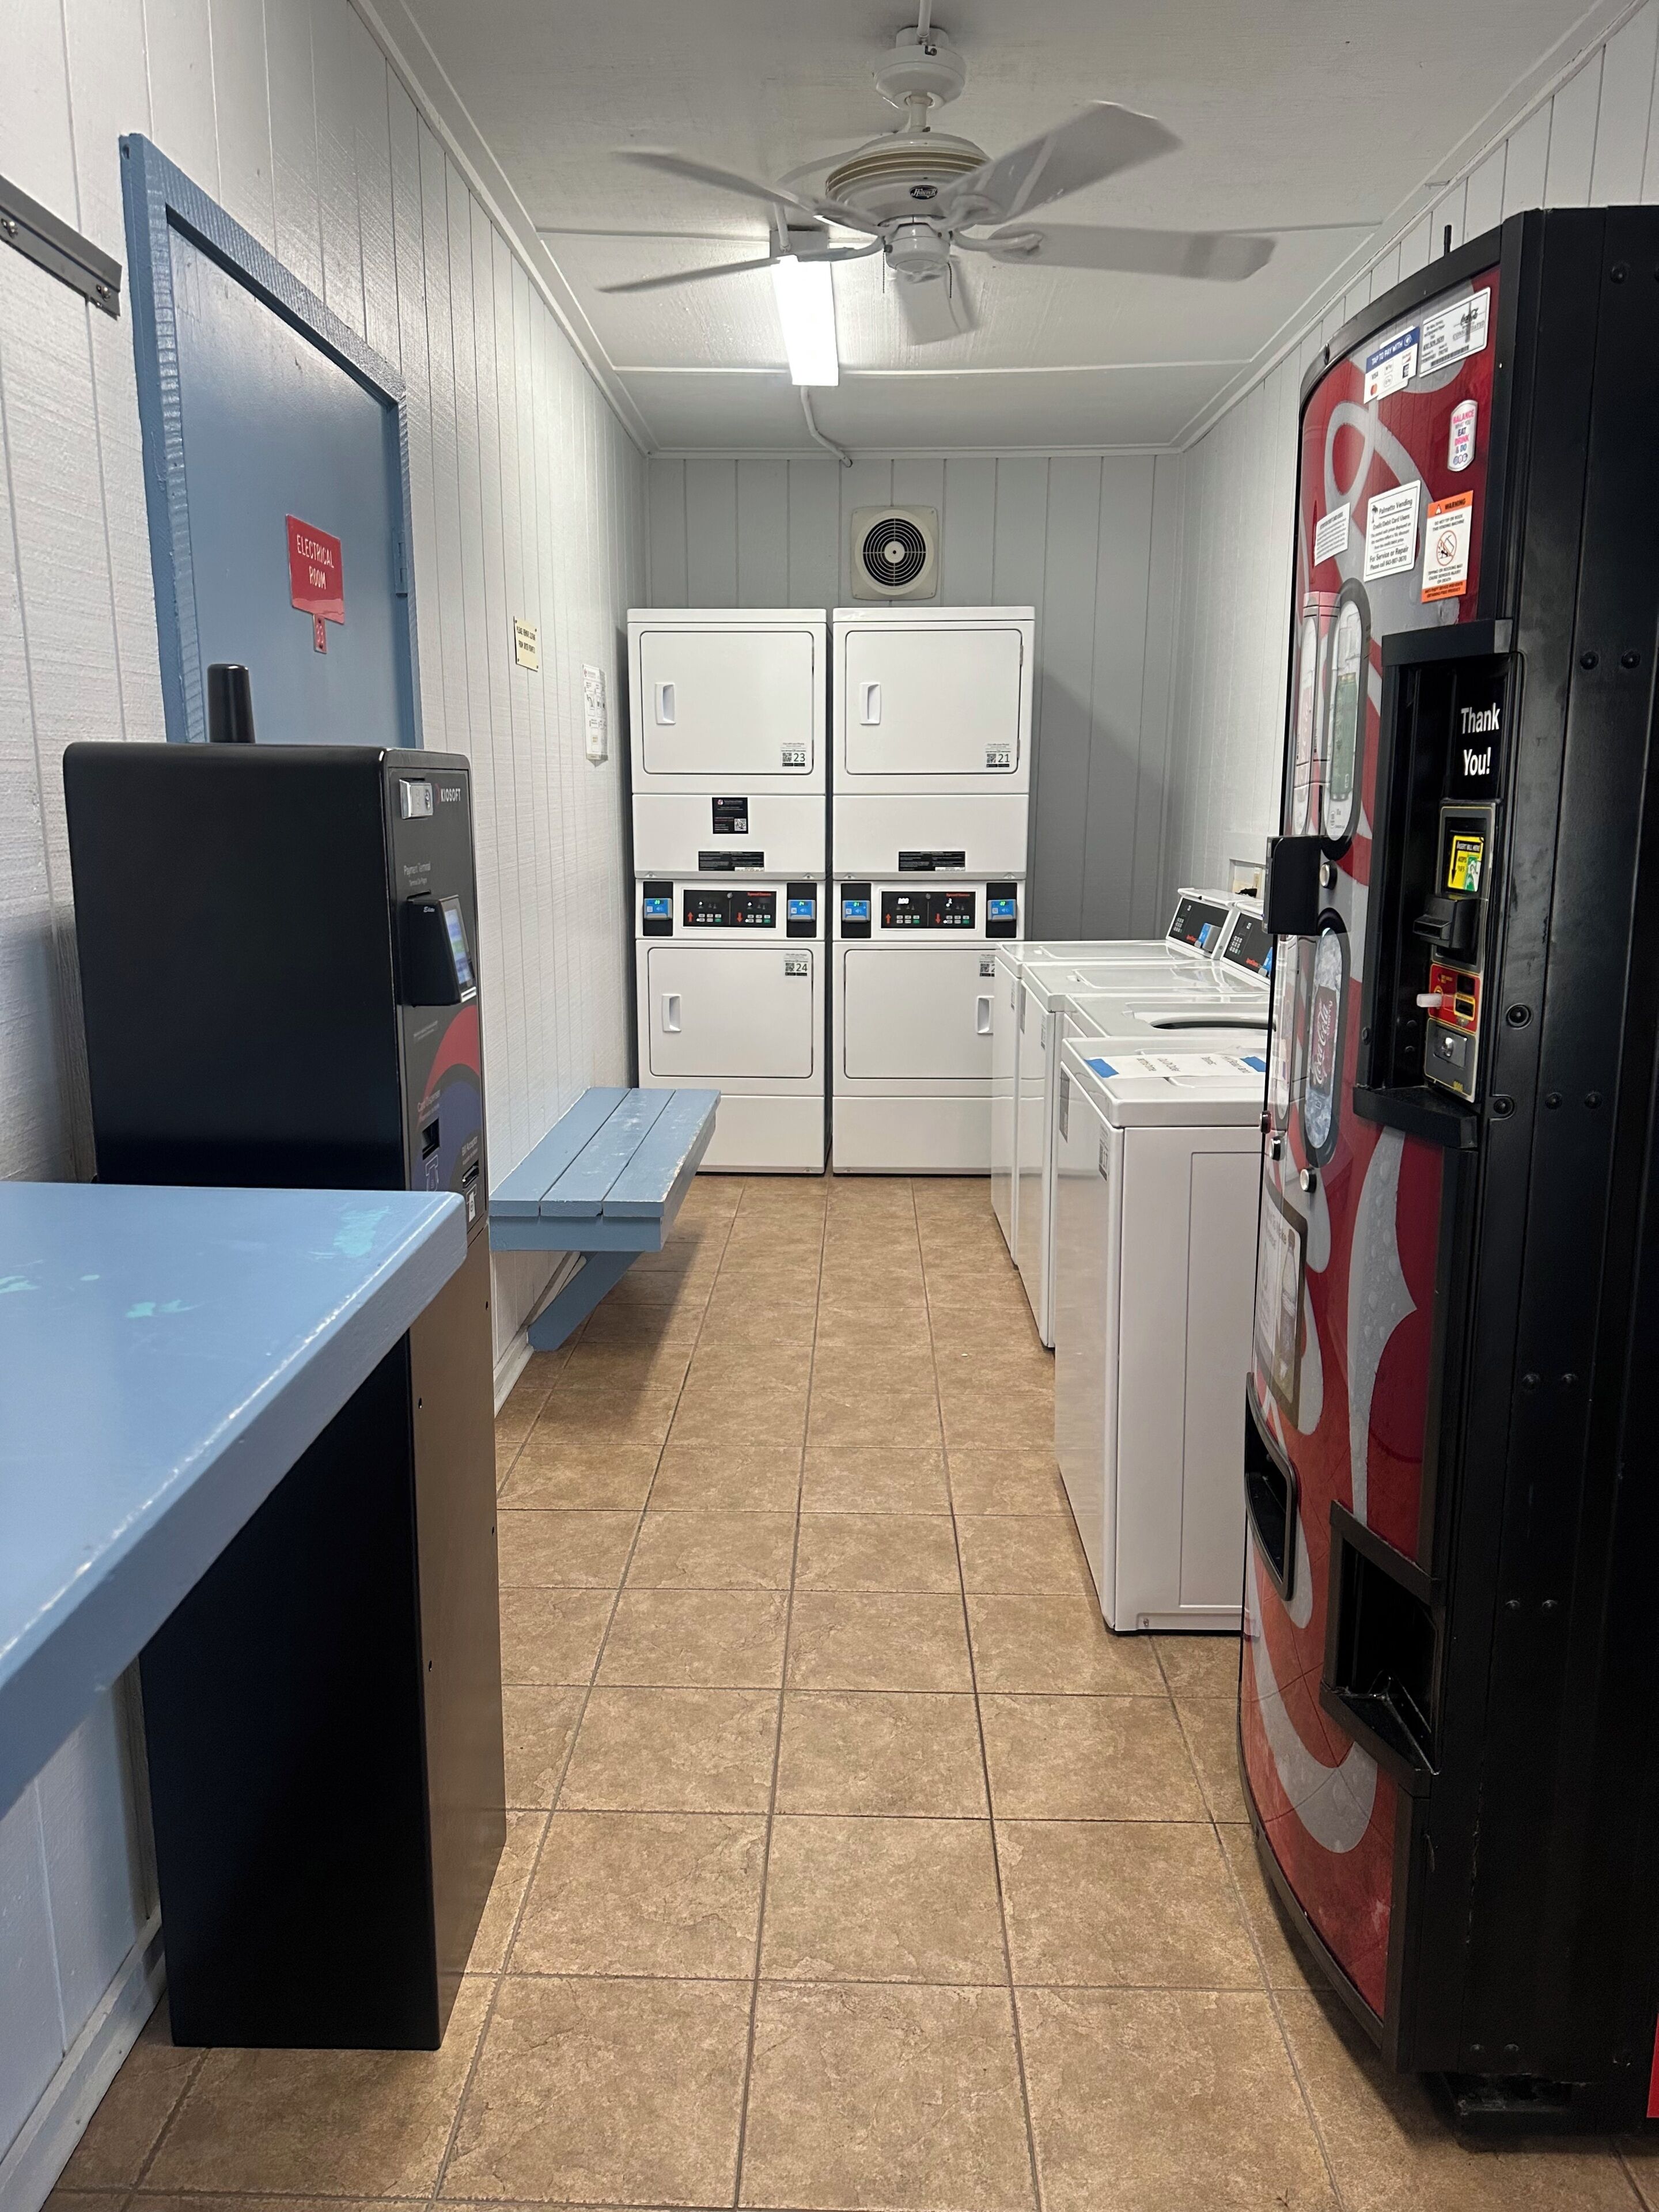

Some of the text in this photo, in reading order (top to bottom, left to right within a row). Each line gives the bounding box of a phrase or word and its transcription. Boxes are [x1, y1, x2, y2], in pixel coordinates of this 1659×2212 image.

[1453, 409, 1474, 424] BALANCE
[1458, 427, 1467, 437] EAT
[1455, 434, 1469, 446] DRINK
[1379, 499, 1412, 514] Palmetto Vending
[1445, 498, 1466, 510] WARNING
[297, 534, 334, 569] ELECTRICAL
[1376, 551, 1389, 560] Service
[1395, 546, 1409, 555] Repair
[309, 565, 326, 590] ROOM
[1461, 702, 1501, 734] Thank
[794, 753, 805, 762] 23
[998, 753, 1010, 763] 21
[1463, 747, 1491, 776] You!
[441, 788, 461, 802] KIOSOFT
[796, 963, 808, 972] 24
